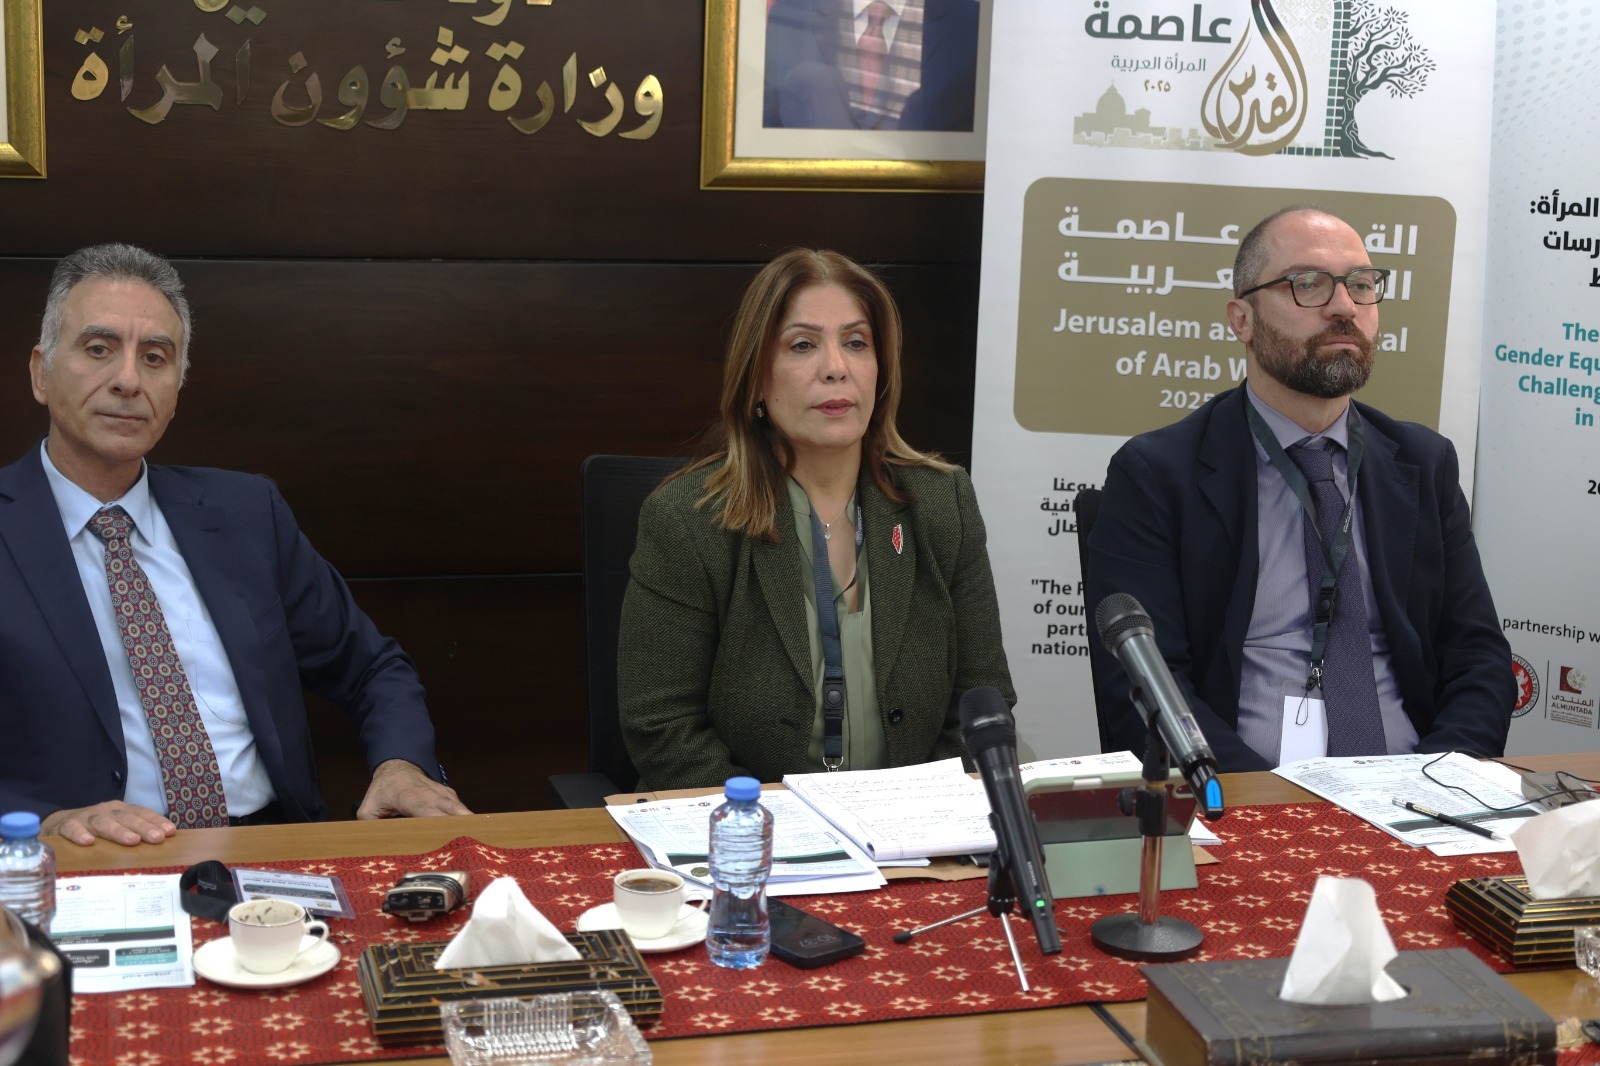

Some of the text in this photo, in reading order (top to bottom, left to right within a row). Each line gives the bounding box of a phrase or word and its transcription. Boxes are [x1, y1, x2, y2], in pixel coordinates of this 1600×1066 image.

[1084, 0, 1232, 44] عاصمة
[1111, 52, 1206, 74] المرأة العربية
[71, 15, 664, 141] وزارة شؤون المرأة
[1143, 79, 1172, 93] ٢٠٢٥
[1364, 222, 1419, 256] الق
[1057, 250, 1235, 296] عربية
[1053, 307, 1201, 340] Jerusalem
[1562, 322, 1600, 343] The
[1115, 350, 1147, 376] of
[1151, 352, 1222, 381] Arab
[1495, 344, 1565, 368] Gender
[1574, 407, 1595, 427] in
[1031, 578, 1072, 596] "The
[1033, 599, 1053, 615] of
[1502, 618, 1586, 644] partnership
[1031, 640, 1090, 657] nation
[1551, 702, 1594, 716] ALMUNTADA
